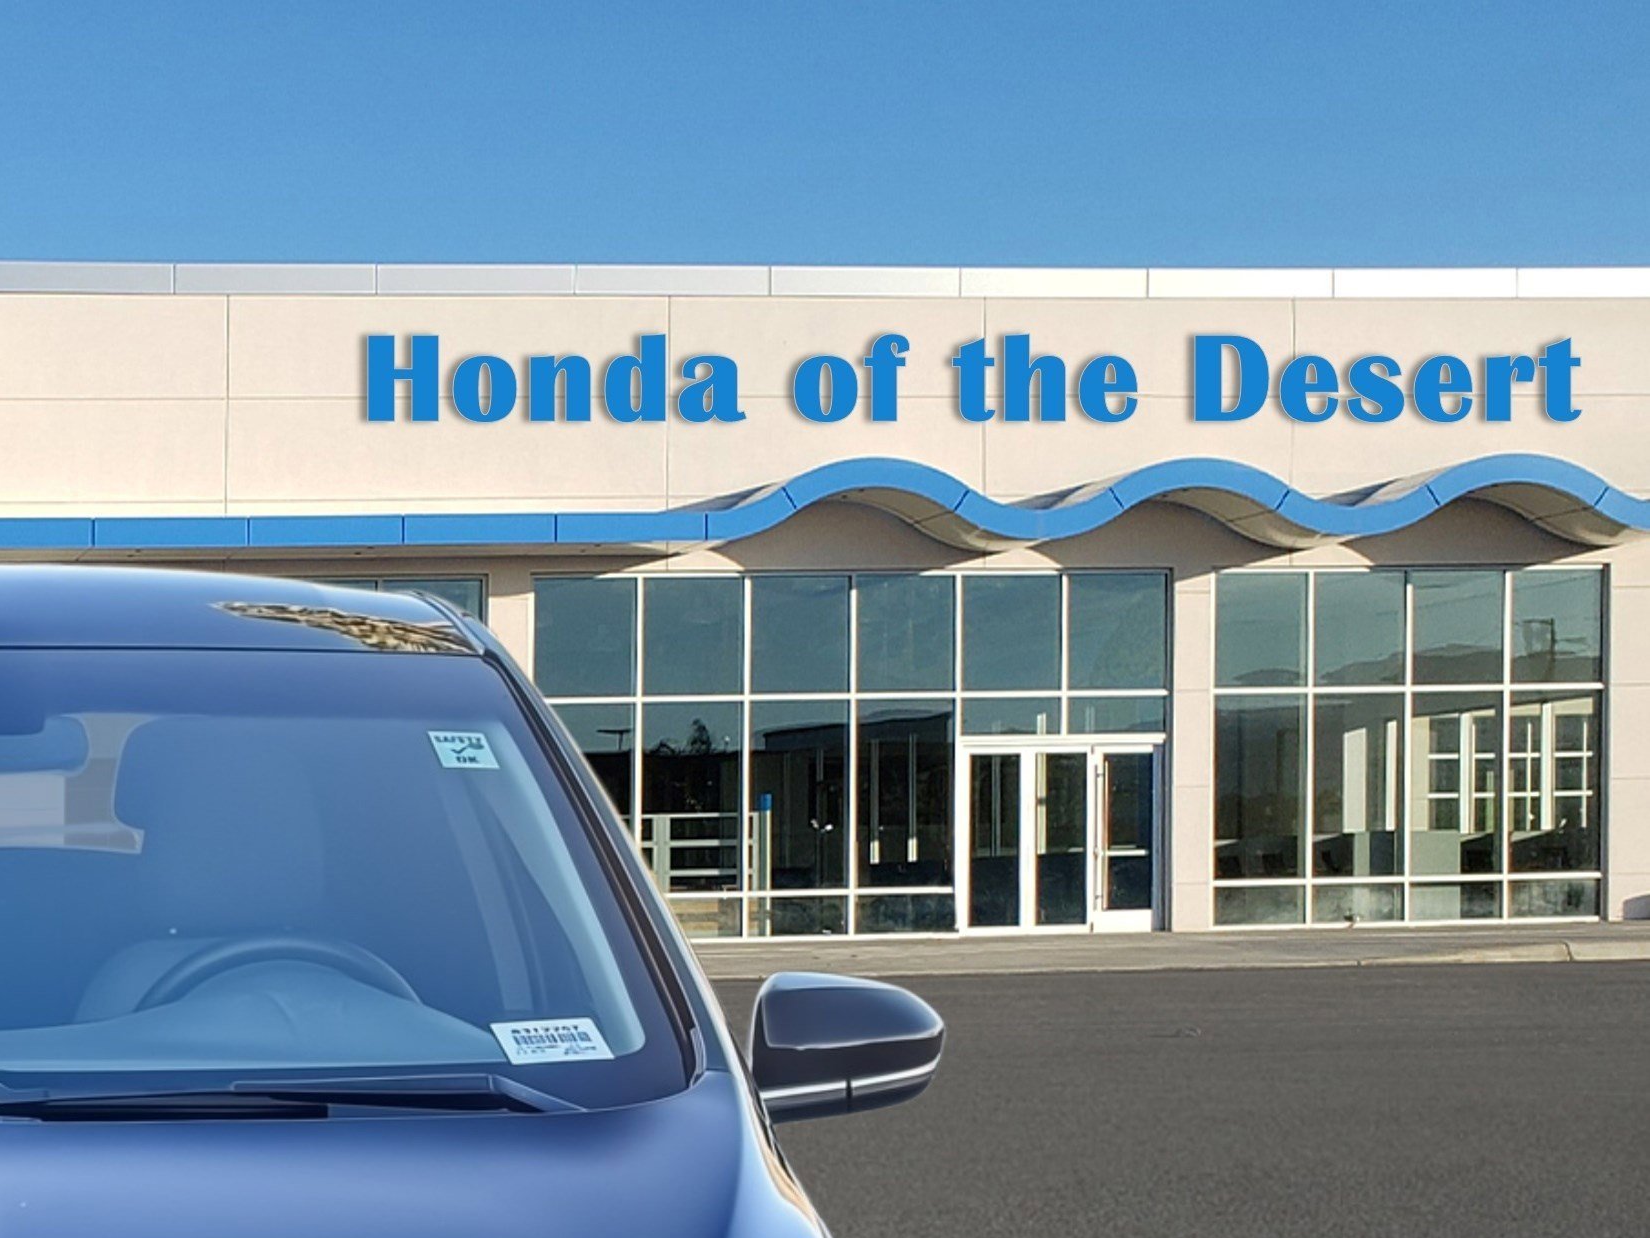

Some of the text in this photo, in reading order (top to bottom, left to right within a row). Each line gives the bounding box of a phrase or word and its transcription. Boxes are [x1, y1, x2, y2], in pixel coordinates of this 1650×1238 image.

[365, 333, 1583, 423] Honda of the Desert
